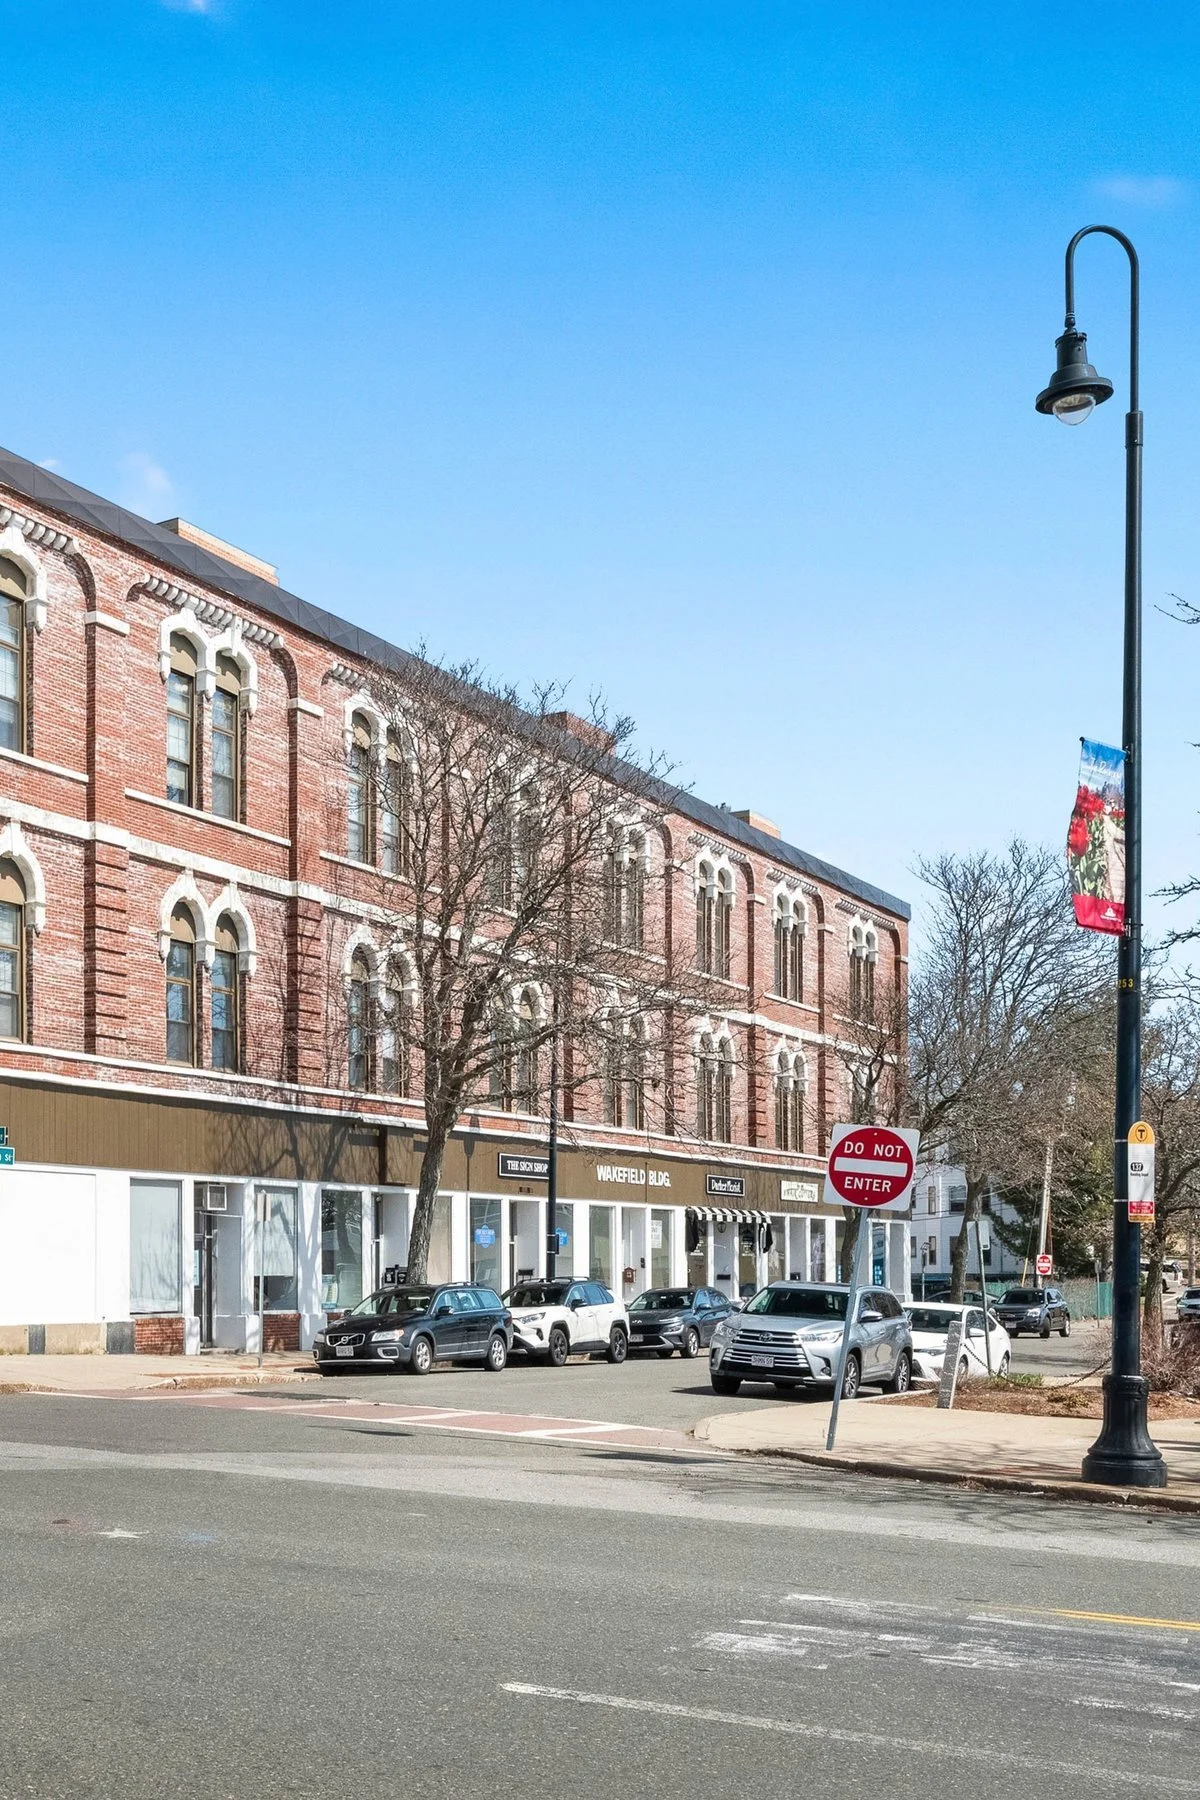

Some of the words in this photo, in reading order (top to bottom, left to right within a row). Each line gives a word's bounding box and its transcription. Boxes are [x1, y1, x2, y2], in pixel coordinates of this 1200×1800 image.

[5, 1153, 12, 1162] St
[844, 1141, 865, 1155] DO
[873, 1144, 904, 1158] NOT
[506, 1159, 519, 1170] THE
[519, 1160, 533, 1172] SIGN
[533, 1162, 549, 1173] SHOP
[596, 1164, 646, 1185] WAKEFIELD
[648, 1170, 672, 1187] BLDG.
[844, 1176, 892, 1193] ENTER
